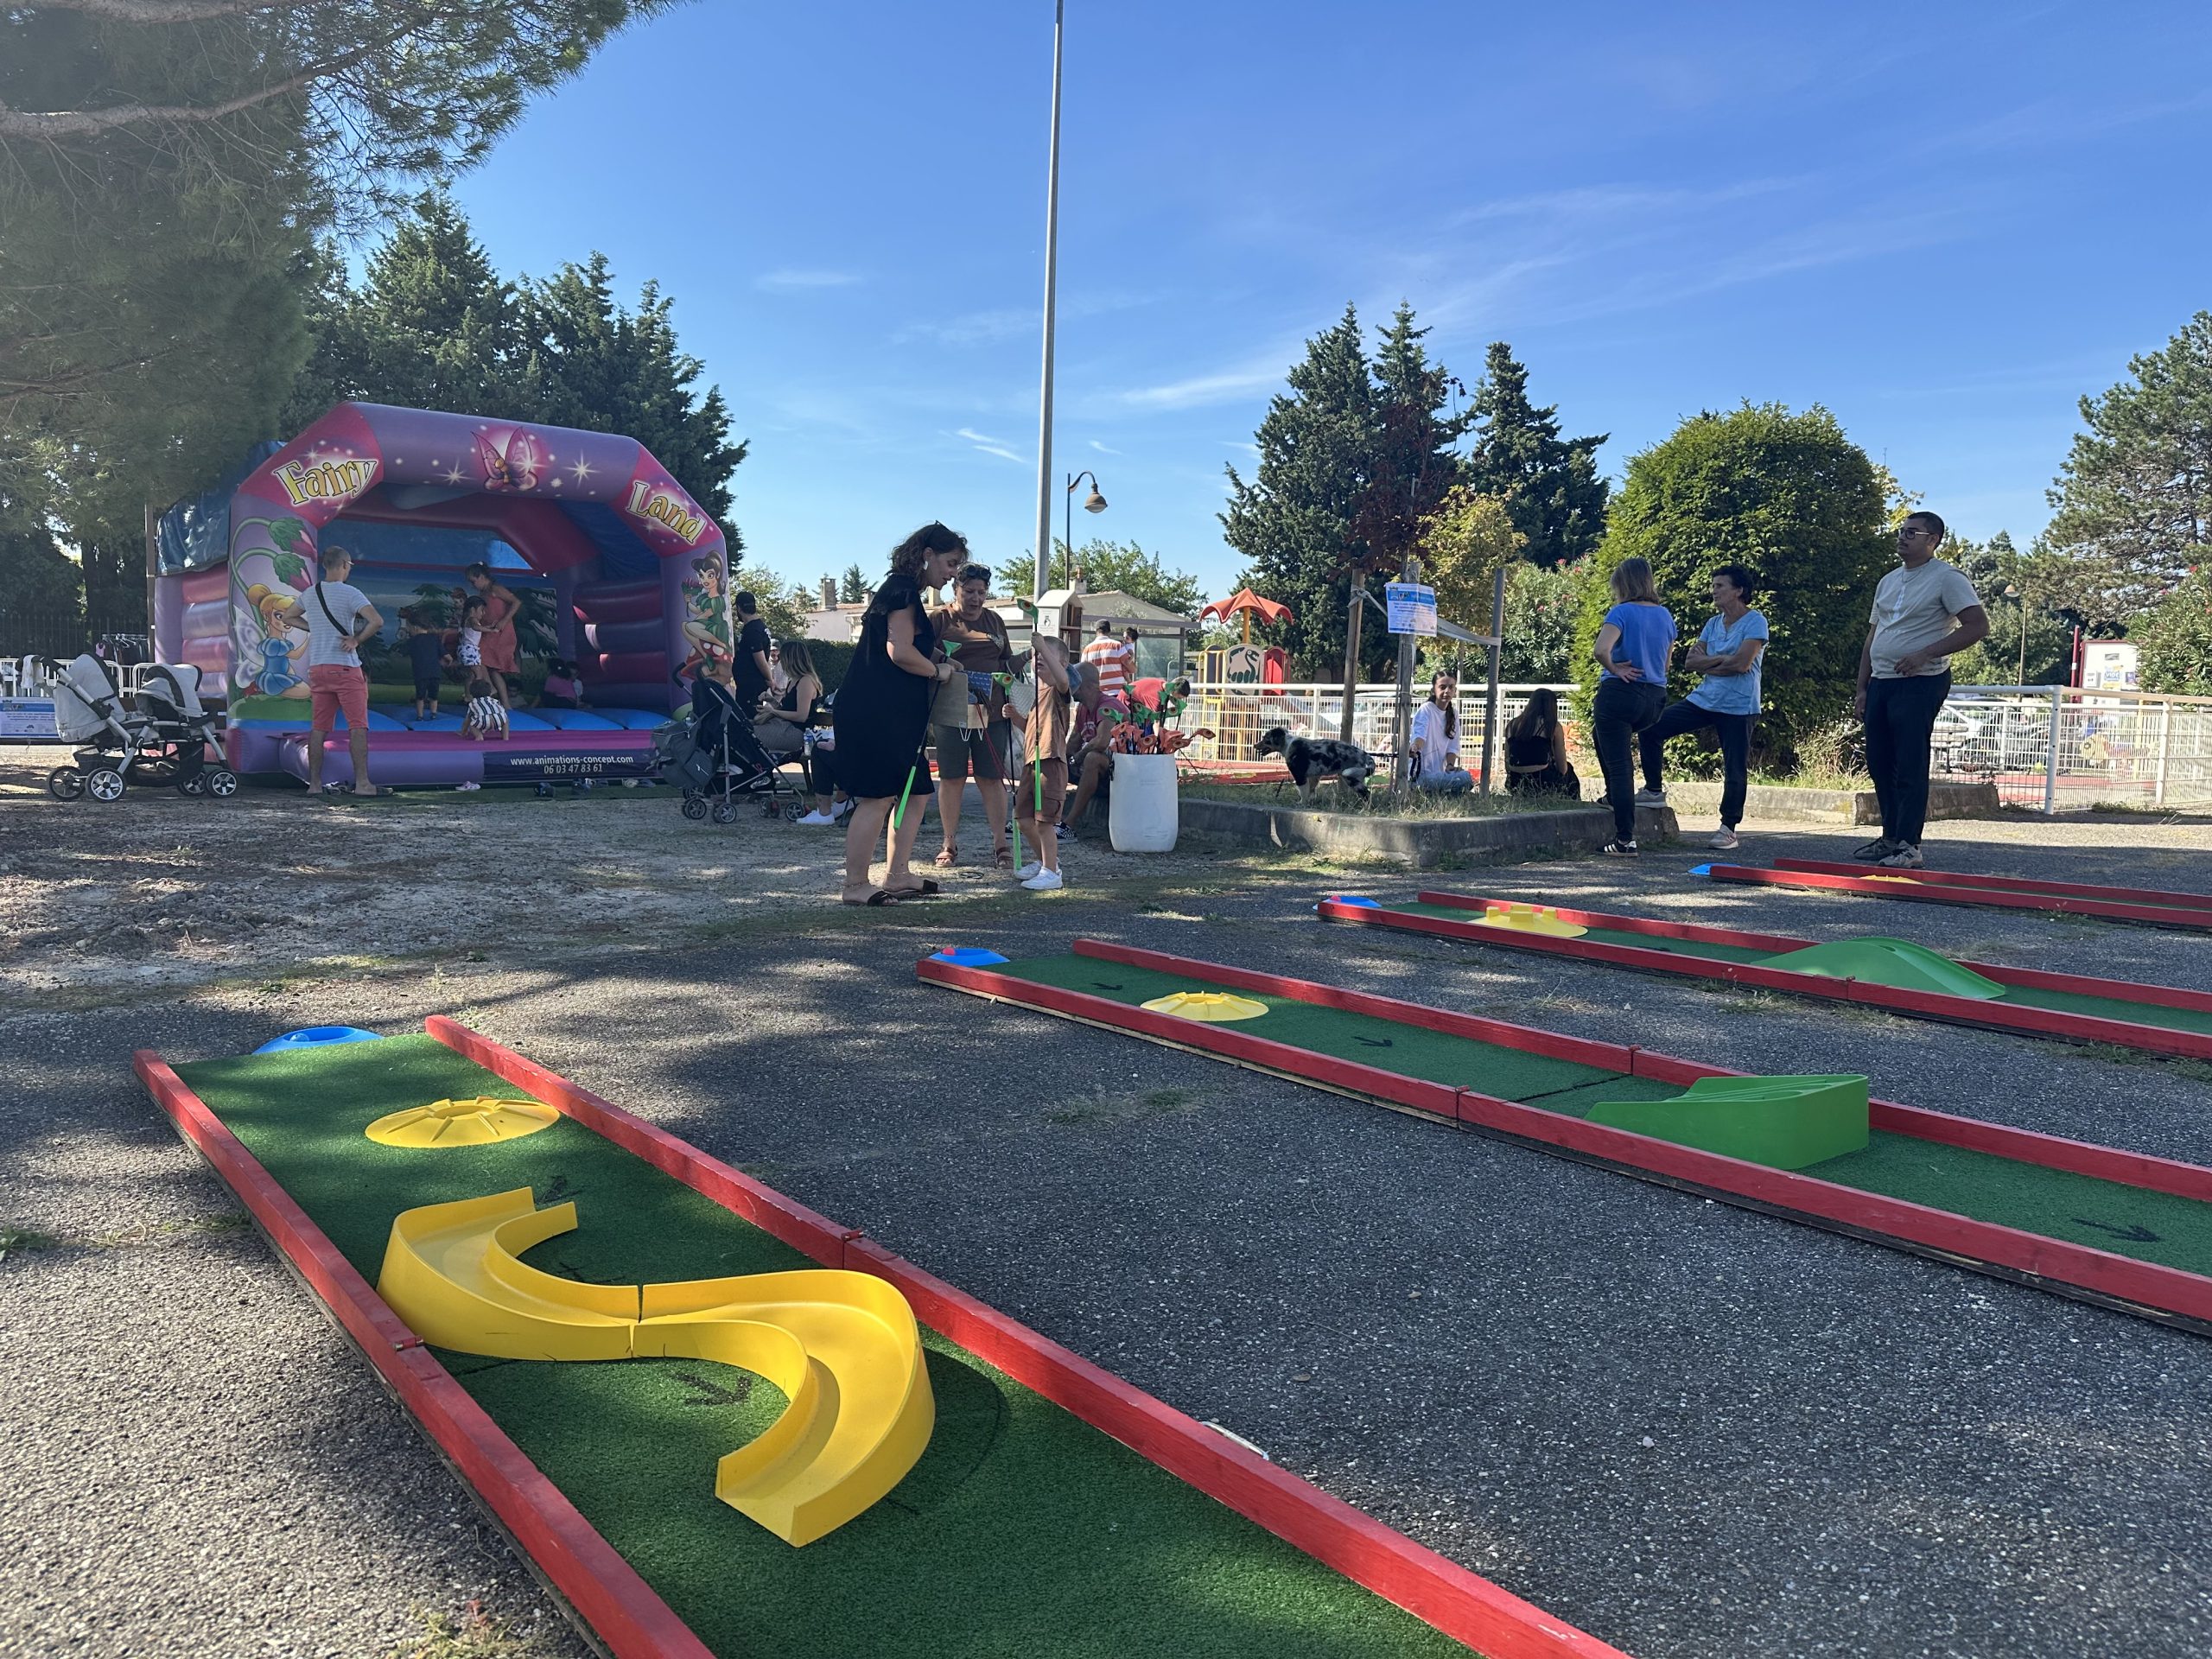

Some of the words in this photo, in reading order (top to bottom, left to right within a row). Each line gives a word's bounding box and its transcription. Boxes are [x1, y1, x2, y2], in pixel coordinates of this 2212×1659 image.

[272, 460, 378, 505] Fairy
[626, 480, 707, 544] Land
[510, 754, 633, 766] www.animations-concept.com
[543, 765, 554, 774] 06
[556, 765, 566, 774] 03
[568, 764, 579, 773] 47
[581, 763, 591, 773] 83
[593, 763, 603, 772] 61
